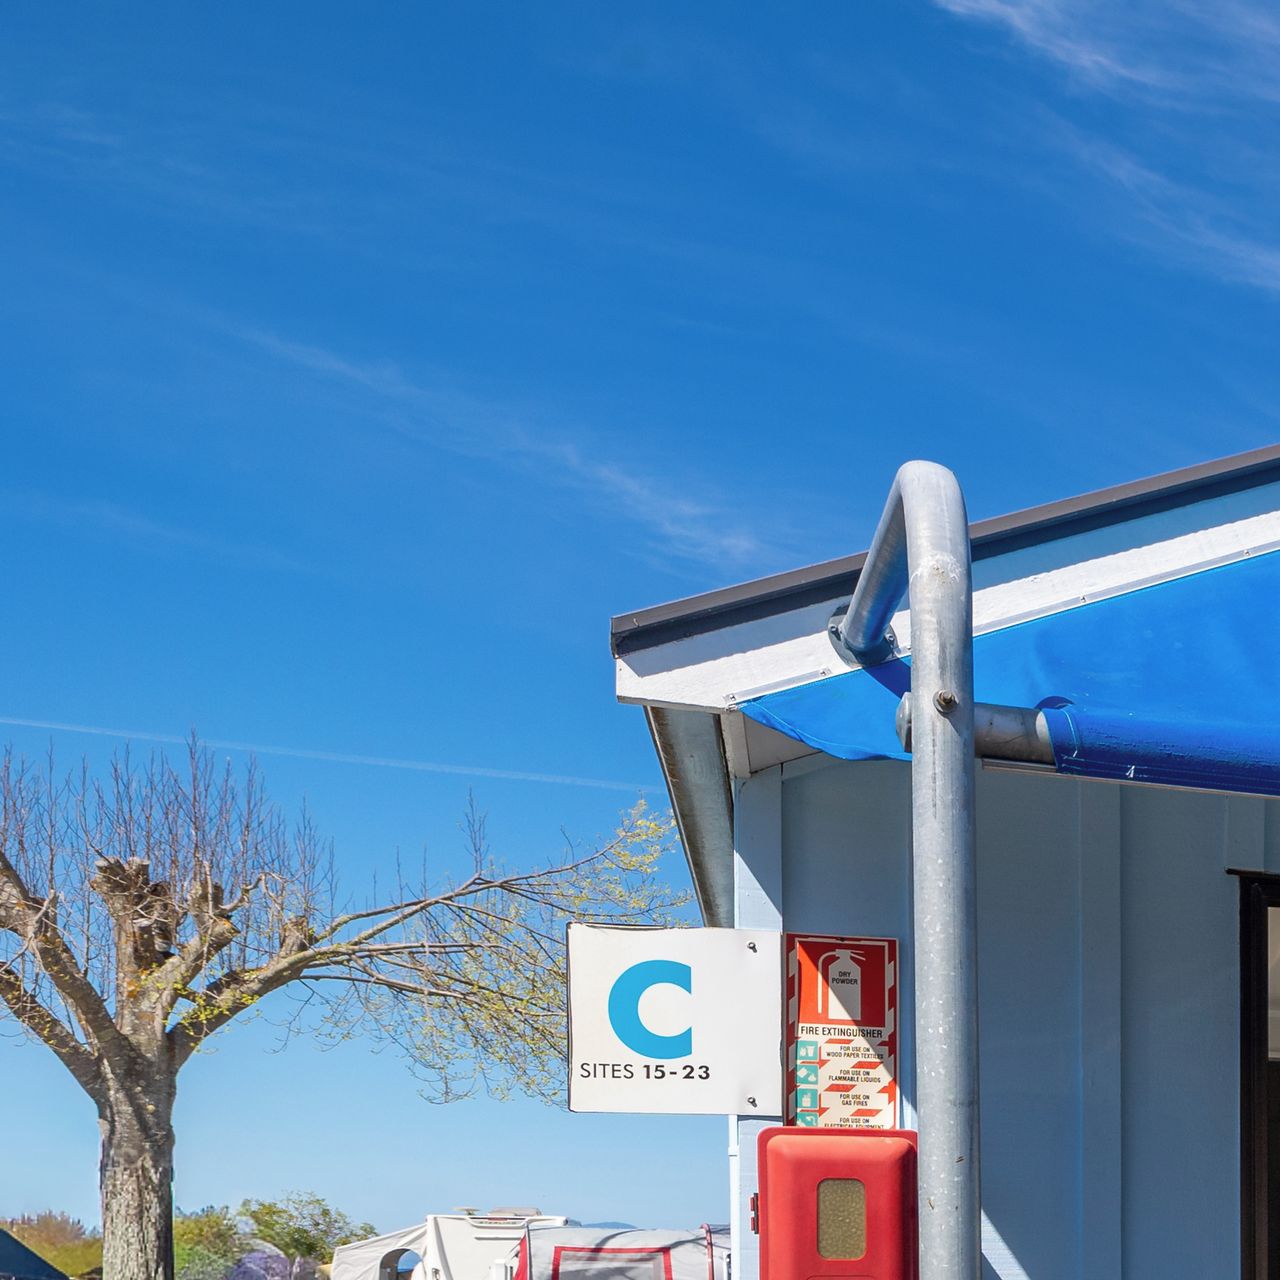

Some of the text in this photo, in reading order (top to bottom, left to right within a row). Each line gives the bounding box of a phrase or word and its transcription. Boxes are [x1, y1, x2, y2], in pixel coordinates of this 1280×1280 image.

[838, 970, 851, 978] DRY
[831, 977, 858, 985] POWDER
[607, 959, 693, 1060] C
[800, 1026, 883, 1038] FIRE EXTINGUISHER
[861, 1052, 884, 1060] TEXTILES
[580, 1062, 711, 1081] SITES 15-23
[828, 1075, 860, 1083] FLAMMABLE
